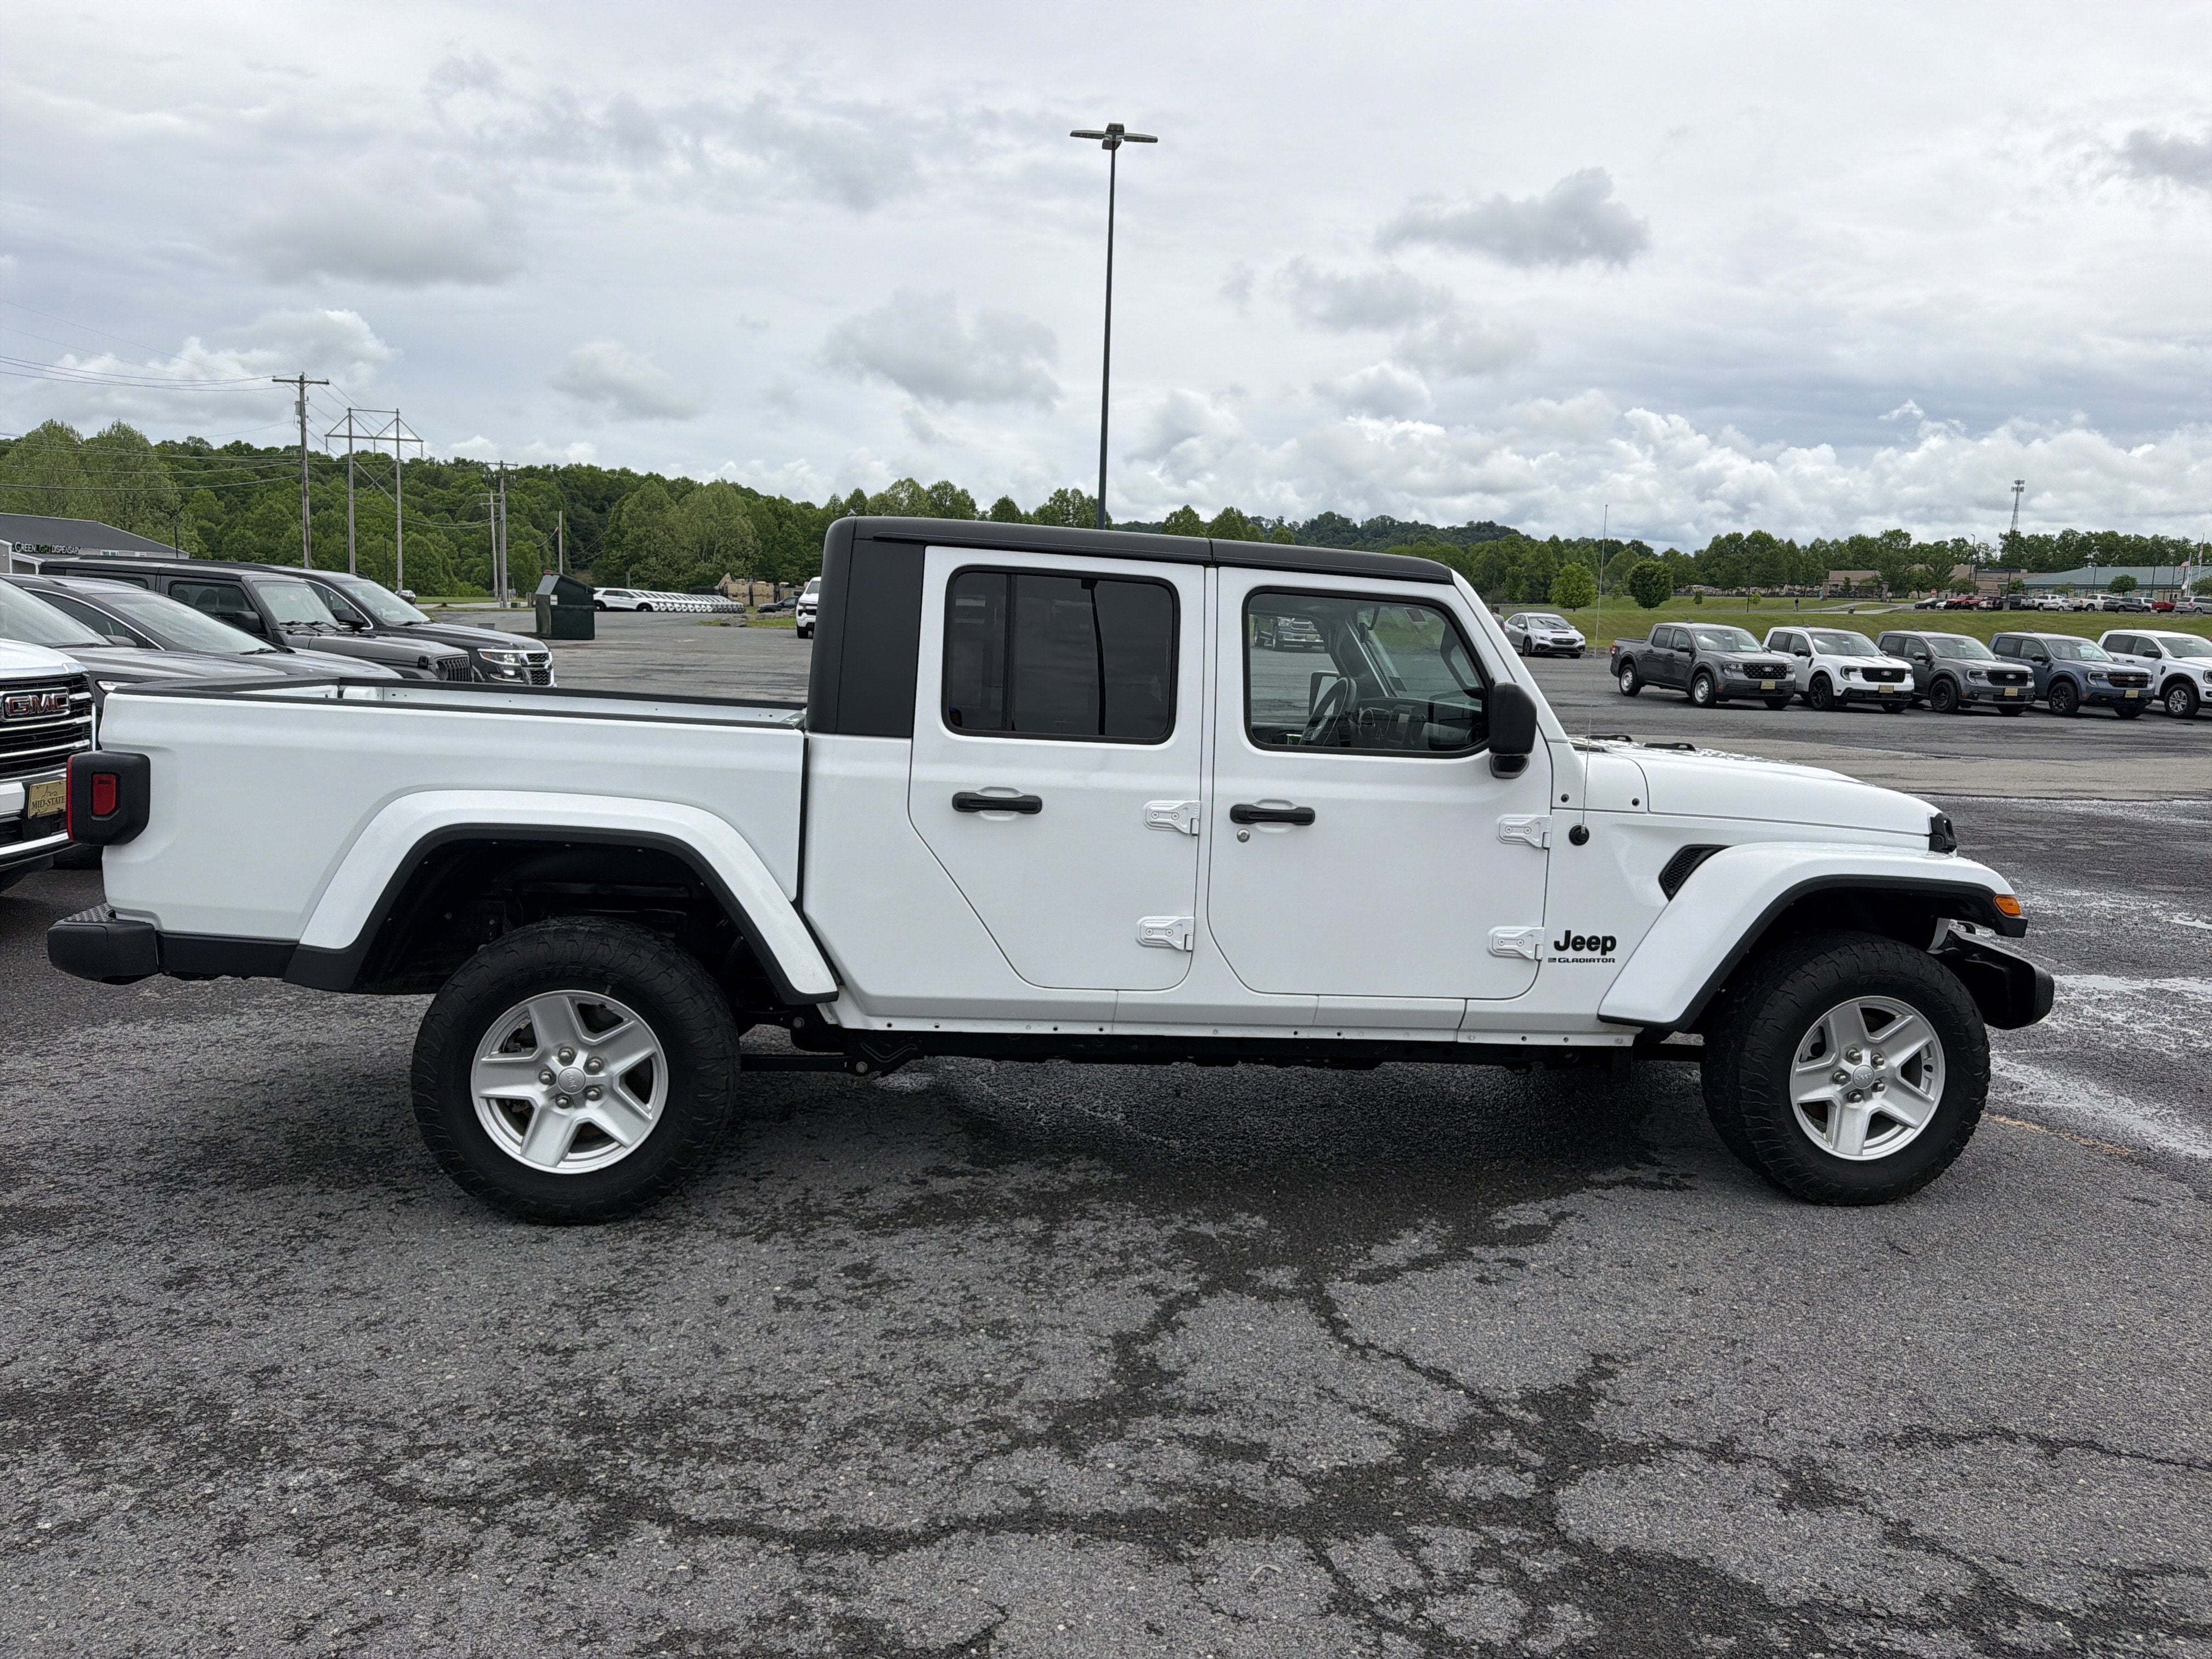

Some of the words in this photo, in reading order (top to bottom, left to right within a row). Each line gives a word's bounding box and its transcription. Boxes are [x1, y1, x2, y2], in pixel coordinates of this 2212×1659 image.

[52, 545, 82, 554] DISPENSARY
[5, 693, 69, 716] GMC
[31, 795, 66, 809] MID-STATE
[1554, 930, 1616, 956] Jeep
